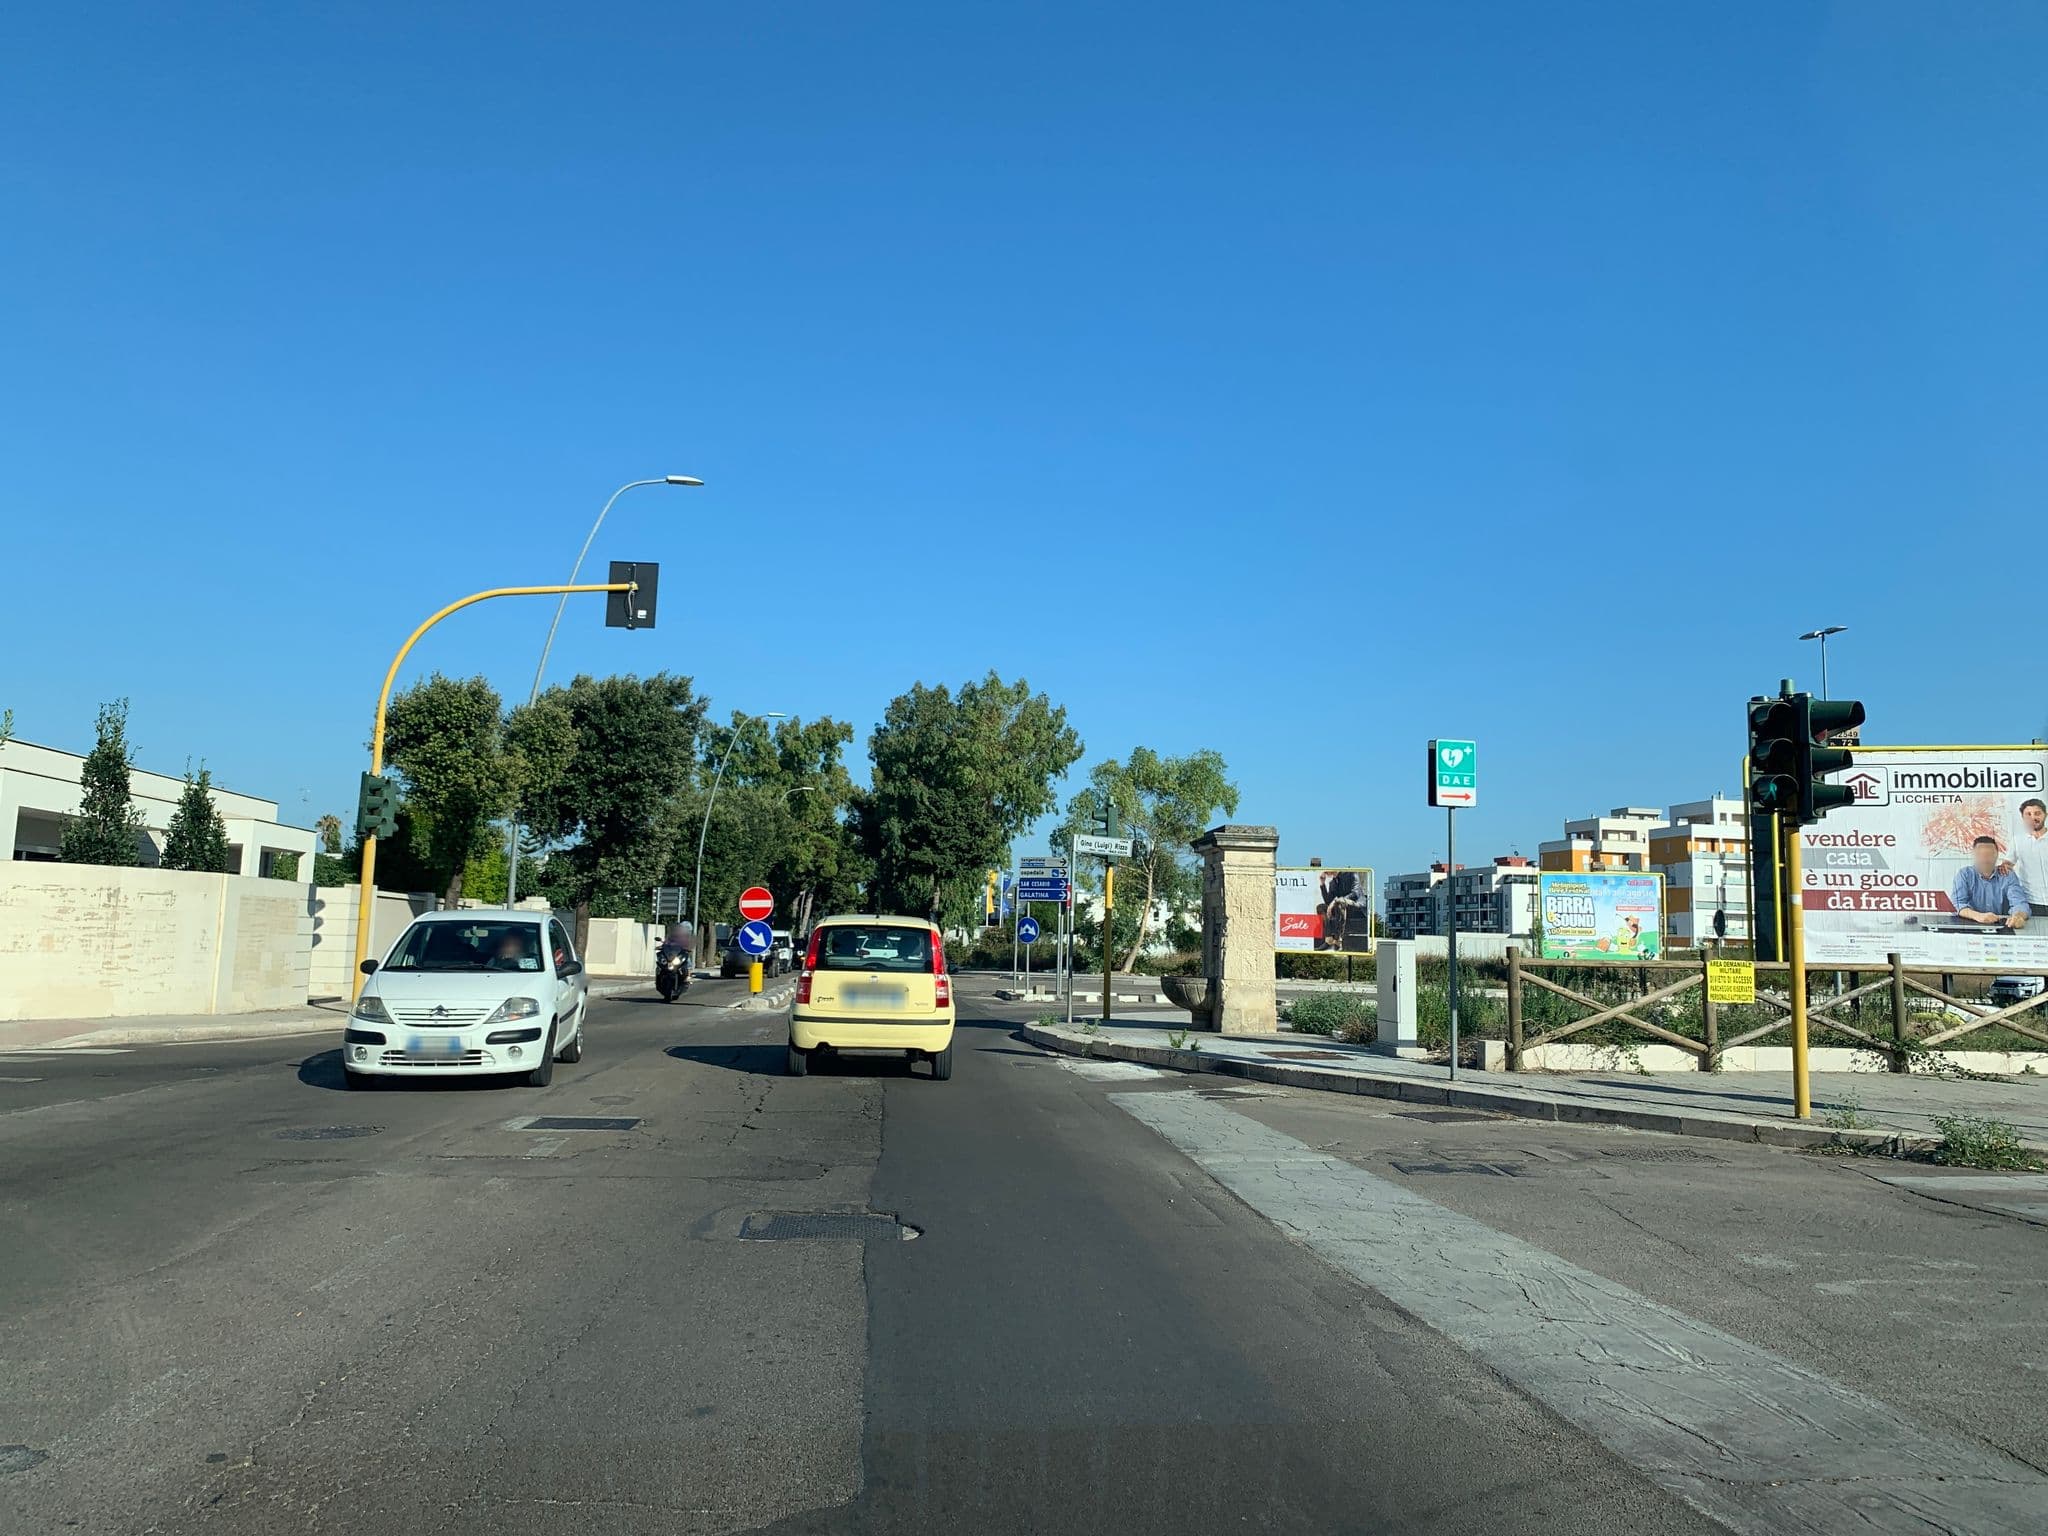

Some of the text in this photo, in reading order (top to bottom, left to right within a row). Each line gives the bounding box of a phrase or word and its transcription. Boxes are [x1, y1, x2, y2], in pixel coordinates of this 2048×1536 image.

[1442, 775, 1471, 786] DAE
[1894, 767, 2037, 788] immobiliare
[1895, 795, 1963, 804] LICCHETTA
[1804, 830, 1897, 847] vendere
[1826, 852, 1872, 866] casa
[1805, 869, 1919, 890] è un gioco
[1827, 891, 1938, 911] da fratelli
[1281, 917, 1309, 932] Sale
[1553, 913, 1596, 928] SOUND
[1733, 976, 1752, 984] ACCESSO
